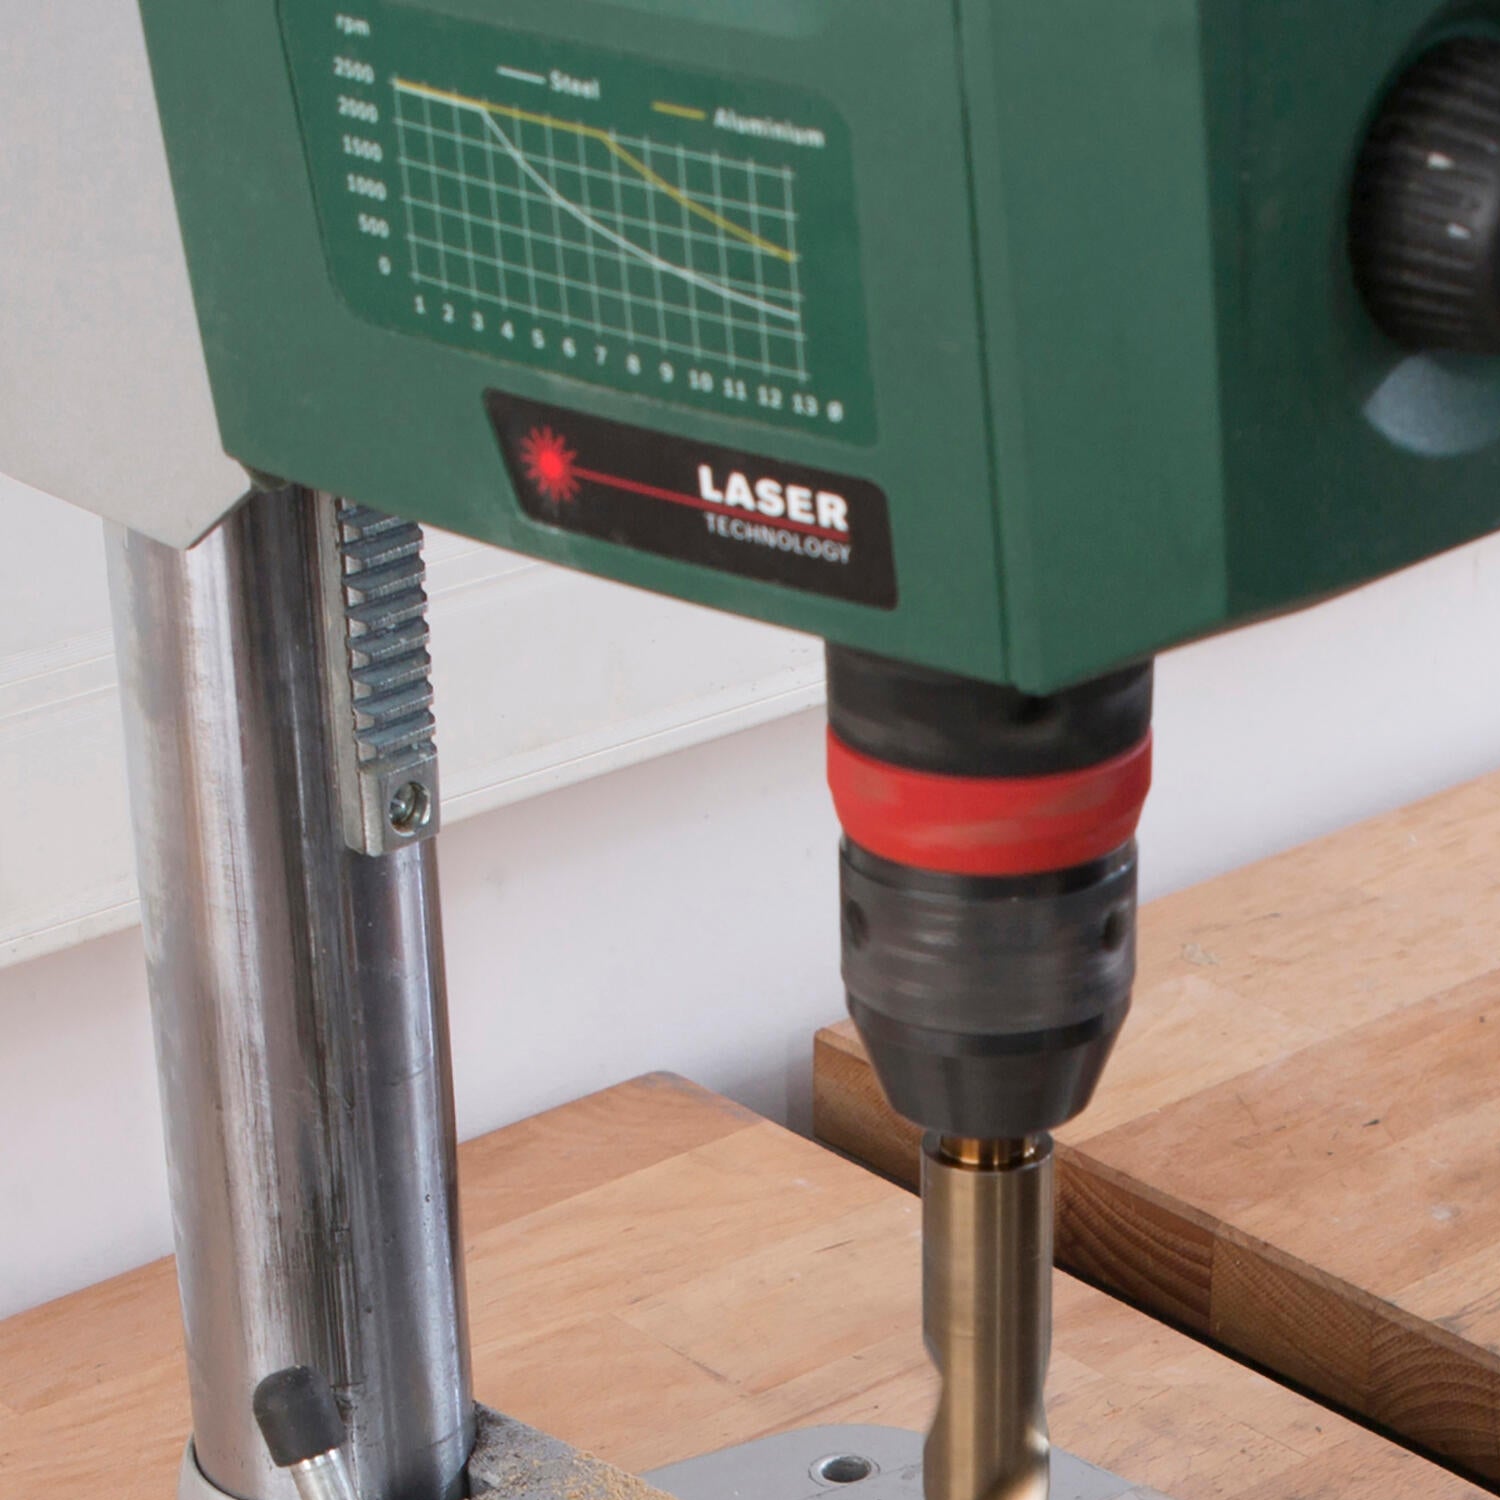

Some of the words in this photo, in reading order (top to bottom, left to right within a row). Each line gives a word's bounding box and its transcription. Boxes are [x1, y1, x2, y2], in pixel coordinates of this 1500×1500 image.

[335, 14, 370, 36] rpm
[551, 69, 600, 100] Steel
[713, 107, 826, 148] Aluminium
[343, 135, 383, 163] 1500
[347, 173, 387, 201] 1000
[358, 213, 390, 239] 500
[378, 255, 391, 276] 0
[414, 295, 426, 315] 1
[442, 302, 455, 324] 2
[472, 311, 484, 332] 3
[502, 320, 515, 341] 4
[531, 328, 545, 349] 5
[562, 337, 576, 359] 6
[594, 344, 608, 366] 7
[626, 353, 641, 375] 8
[659, 362, 674, 383] 9
[688, 369, 714, 393] 10
[723, 377, 747, 401] 11
[757, 385, 783, 410] 12
[792, 392, 818, 417] 13
[698, 464, 849, 532] LASER
[704, 512, 852, 564] TECHNOLOGY
